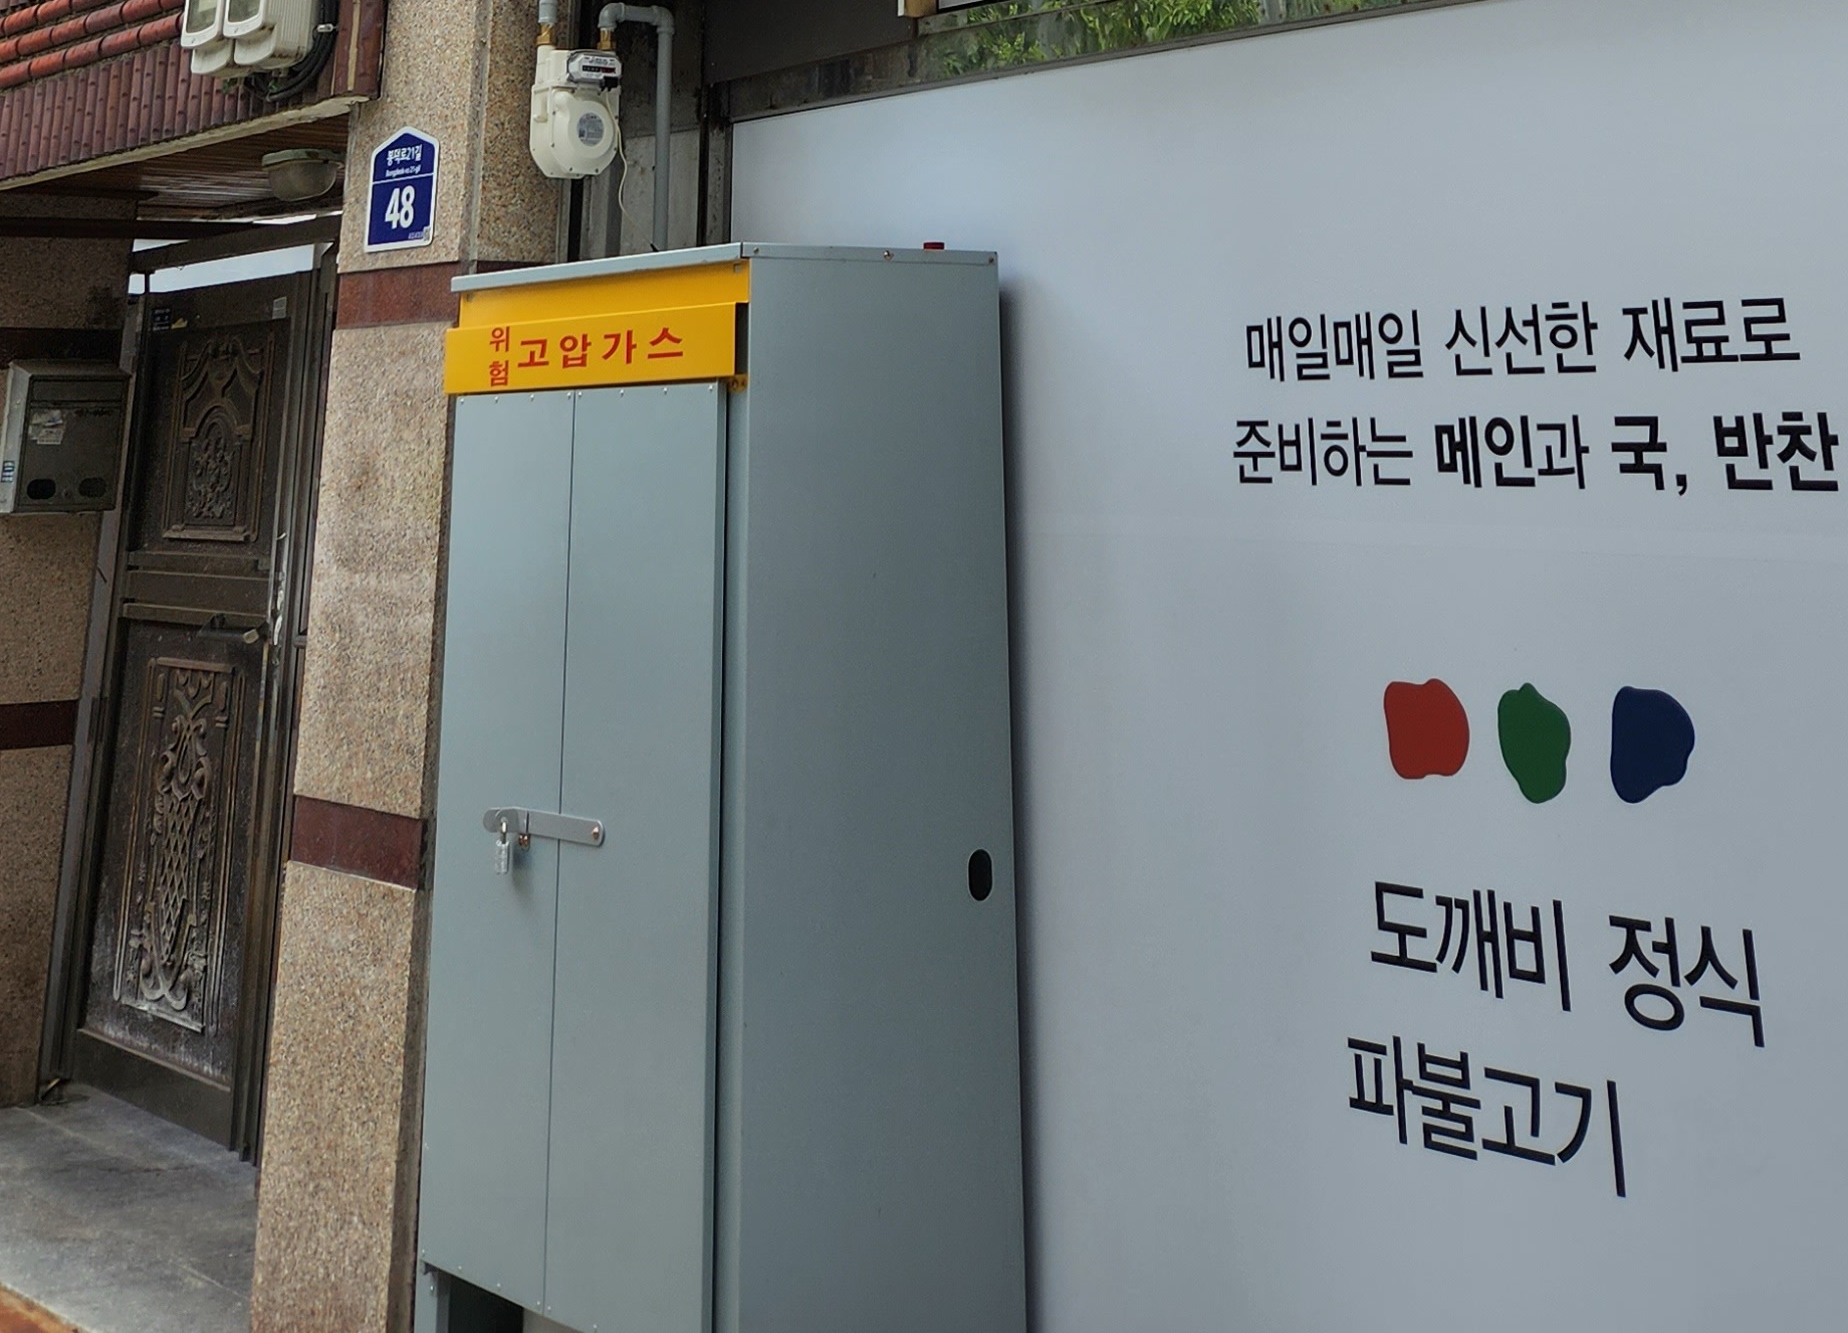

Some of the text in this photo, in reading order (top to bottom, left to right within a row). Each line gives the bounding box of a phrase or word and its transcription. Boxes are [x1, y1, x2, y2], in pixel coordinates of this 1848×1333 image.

[386, 143, 423, 166] 봉덕로21길
[384, 185, 415, 230] 48
[488, 325, 511, 387] 위험
[517, 326, 684, 369] 고압가스
[1246, 297, 1801, 382] 매일매일 신선한 재료로
[1233, 411, 1840, 496] 준비하는 메인과 국, 반찬
[1370, 881, 1765, 1048] 도깨비 정식
[1347, 1035, 1626, 1198] 파불고기
